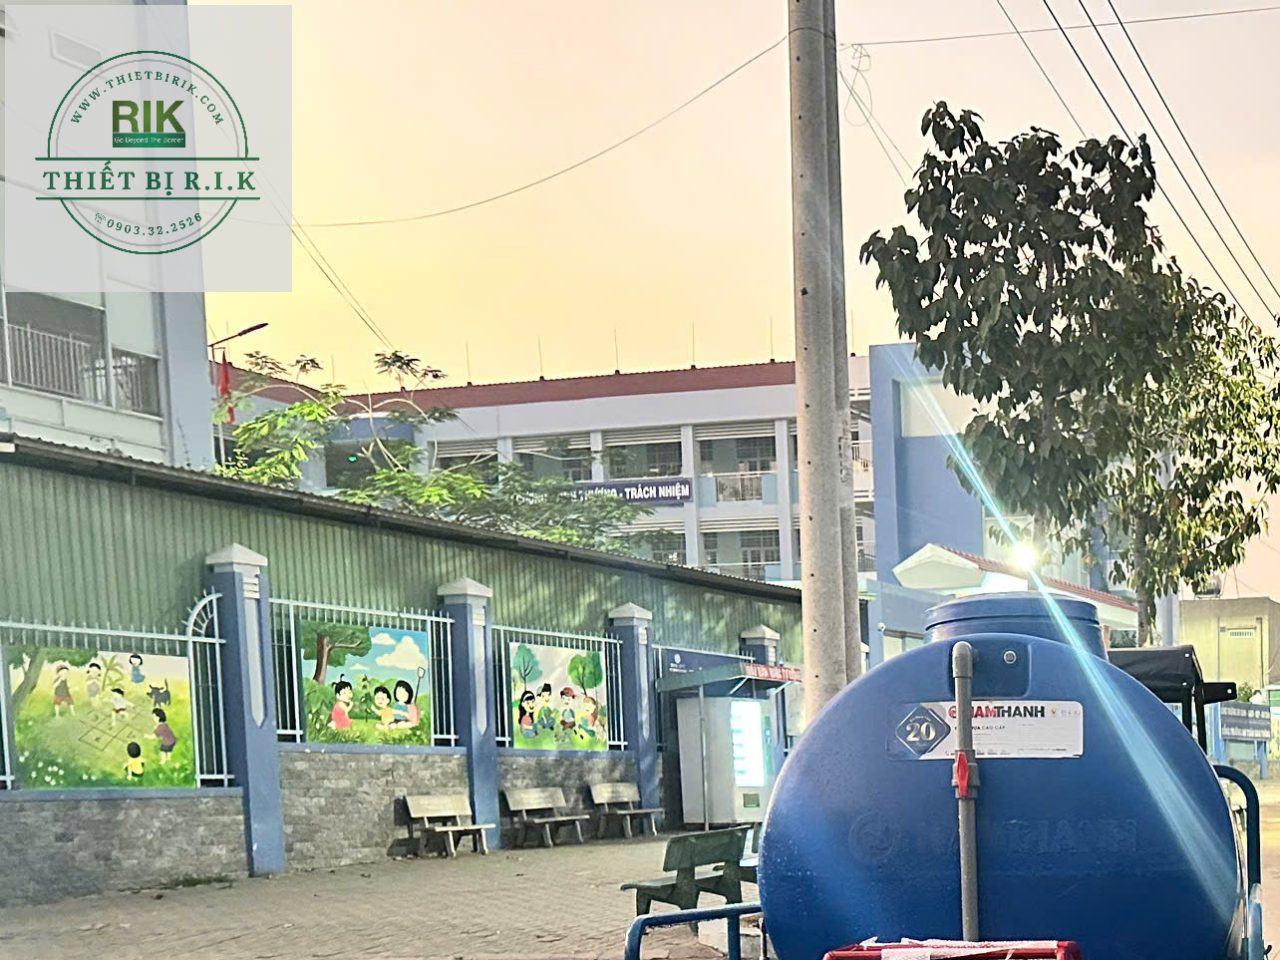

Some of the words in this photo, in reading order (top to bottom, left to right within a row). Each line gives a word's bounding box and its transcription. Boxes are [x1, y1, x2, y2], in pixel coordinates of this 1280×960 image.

[624, 483, 657, 499] TRÁCH
[658, 482, 690, 499] NHIỆM
[906, 722, 936, 742] 20
